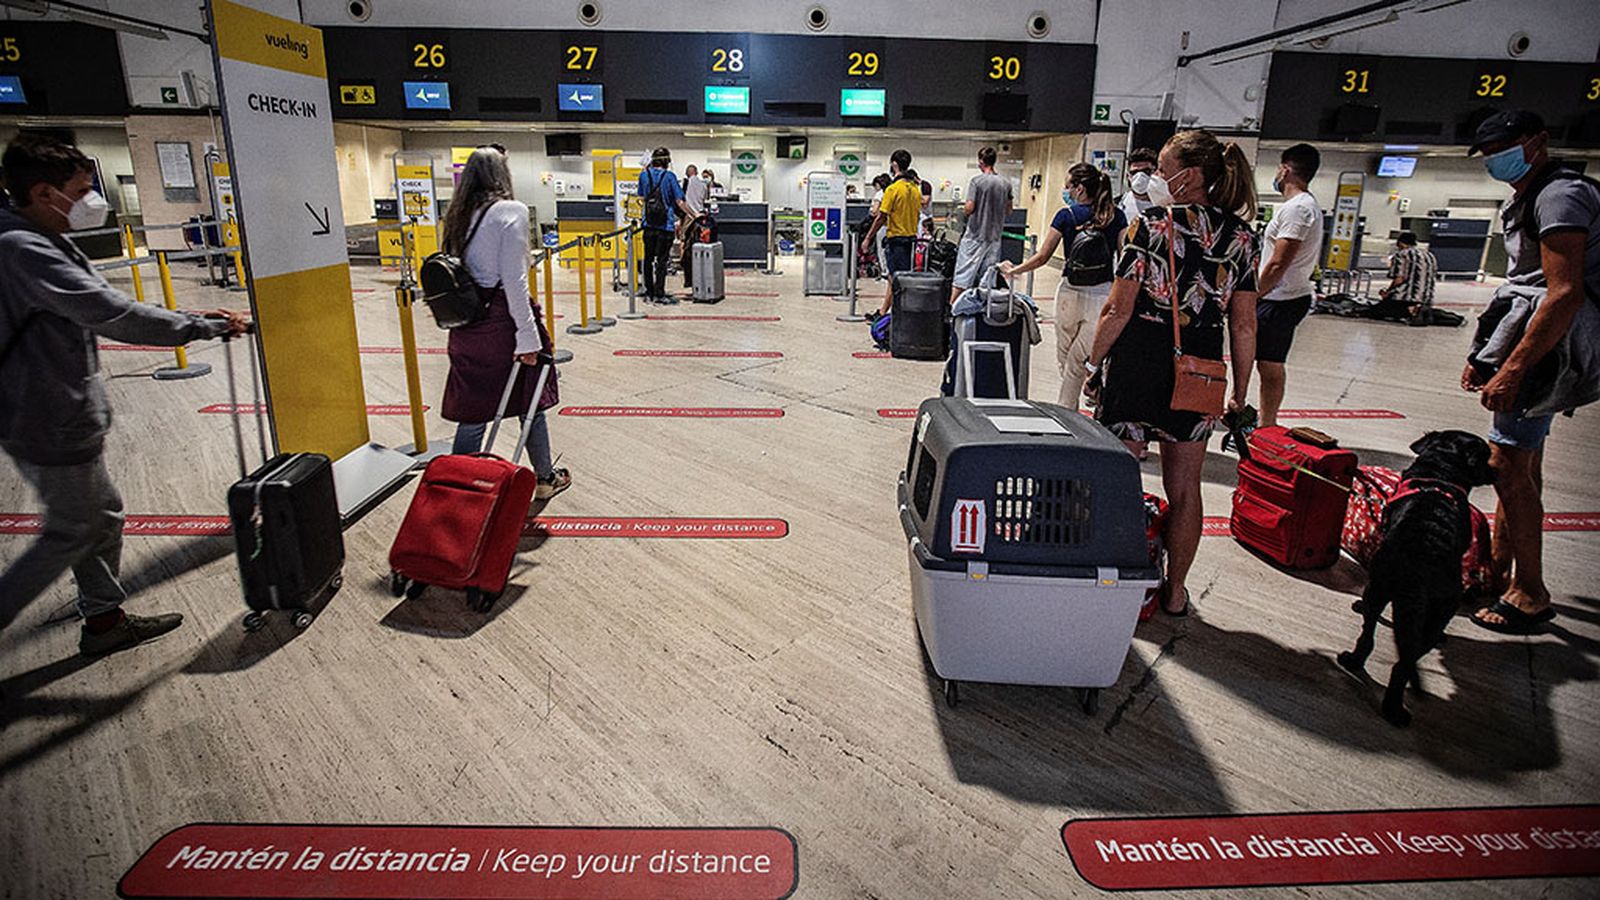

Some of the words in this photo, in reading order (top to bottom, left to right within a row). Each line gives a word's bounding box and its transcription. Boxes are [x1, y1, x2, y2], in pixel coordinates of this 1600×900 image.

[0, 38, 20, 61] 5
[265, 33, 308, 59] vueling
[413, 44, 446, 68] 26
[566, 46, 598, 70] 27
[712, 49, 744, 72] 28
[847, 52, 879, 76] 29
[989, 56, 1020, 80] 30
[1342, 70, 1370, 94] 31
[1476, 75, 1507, 98] 32
[1587, 78, 1600, 100] 3
[248, 93, 317, 118] CHECK-IN
[551, 522, 622, 531] distancia
[633, 523, 669, 533] Keep
[674, 524, 710, 533] your
[711, 524, 776, 532] distance
[1095, 837, 1211, 863] Mantén
[1209, 836, 1244, 860] la
[1246, 832, 1380, 859] distancia
[1386, 831, 1465, 857] Keep
[1462, 833, 1529, 857] your
[1530, 827, 1600, 849] dista
[166, 845, 289, 871] Mantén
[292, 846, 325, 871] la
[329, 847, 471, 872] distancia
[492, 848, 566, 879] Keep
[571, 854, 642, 879] your
[649, 849, 771, 873] distance
